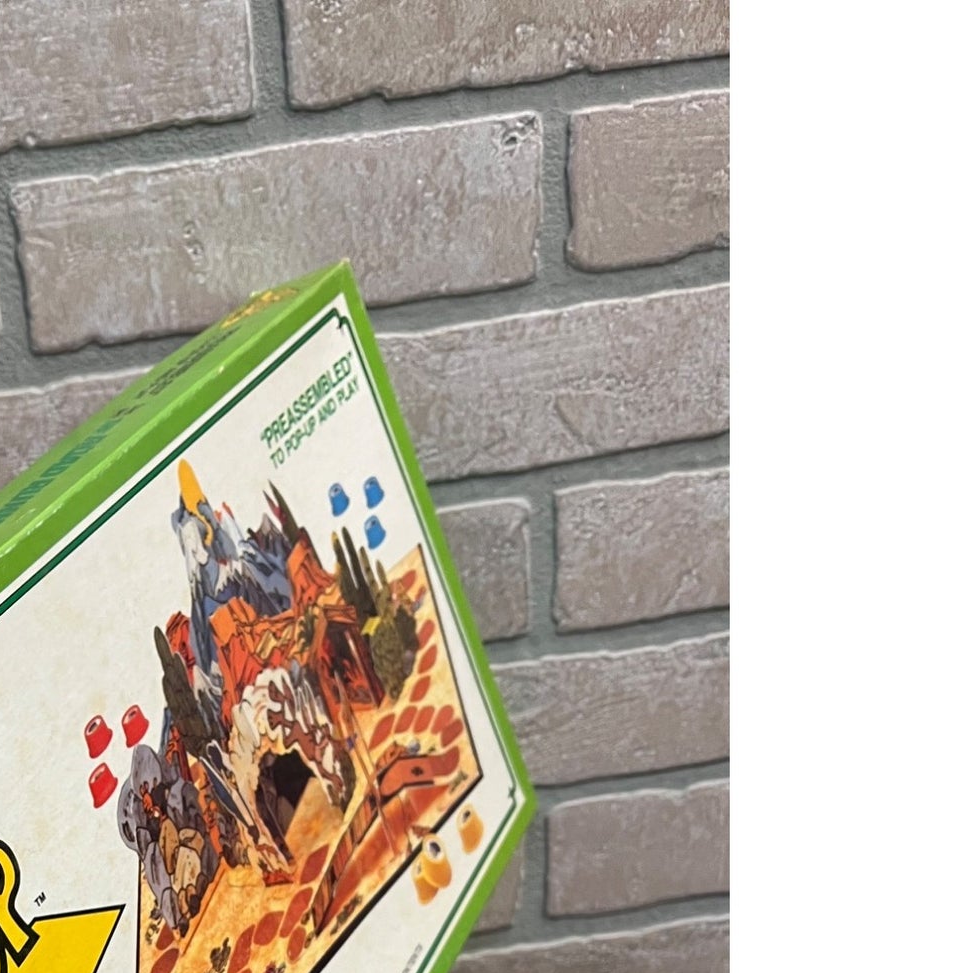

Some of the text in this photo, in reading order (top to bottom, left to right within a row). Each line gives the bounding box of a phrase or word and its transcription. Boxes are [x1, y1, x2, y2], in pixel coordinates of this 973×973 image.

[270, 447, 285, 470] TO
[318, 398, 337, 424] AND
[336, 375, 359, 406] PLAY
